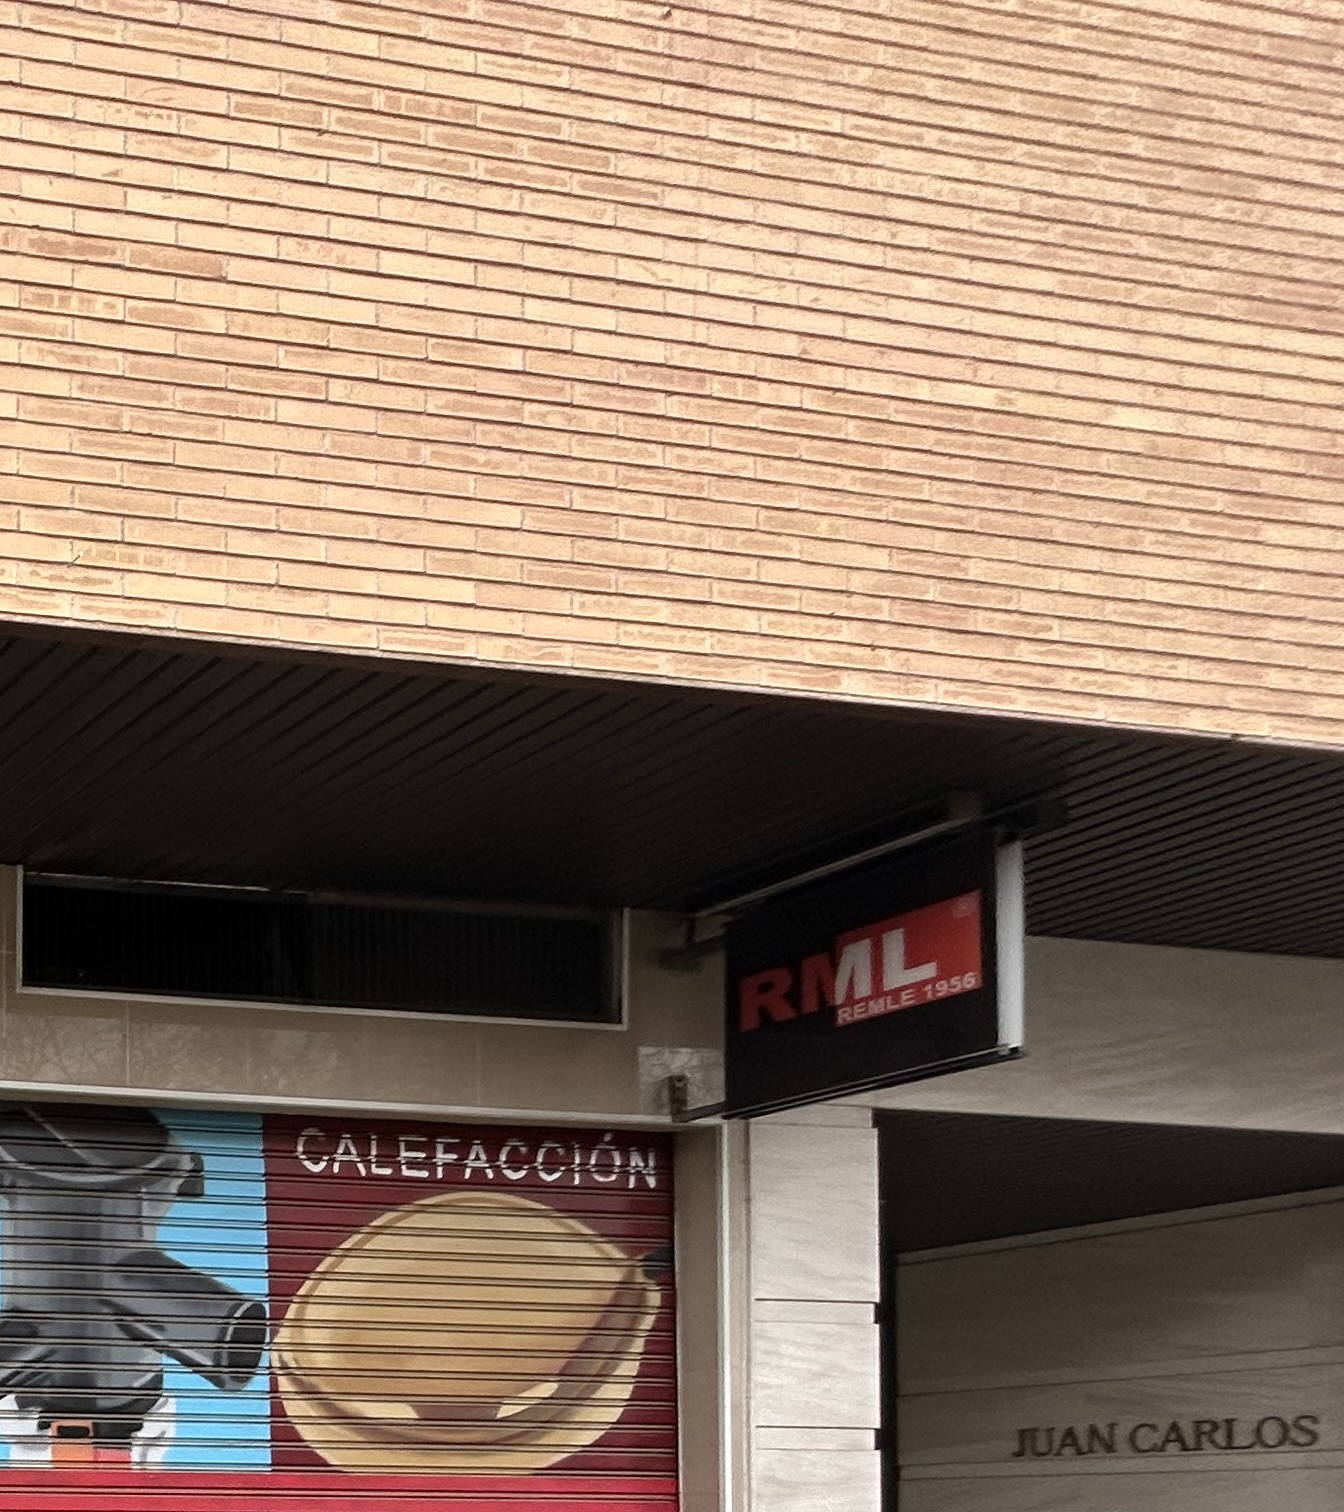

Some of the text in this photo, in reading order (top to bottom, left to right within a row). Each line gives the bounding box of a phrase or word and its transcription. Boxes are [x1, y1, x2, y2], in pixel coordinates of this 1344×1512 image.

[837, 972, 977, 1023] REMLE 1956
[295, 1127, 658, 1190] CALEFACCIÓN
[1013, 1415, 1320, 1458] JUAN CARLOS
